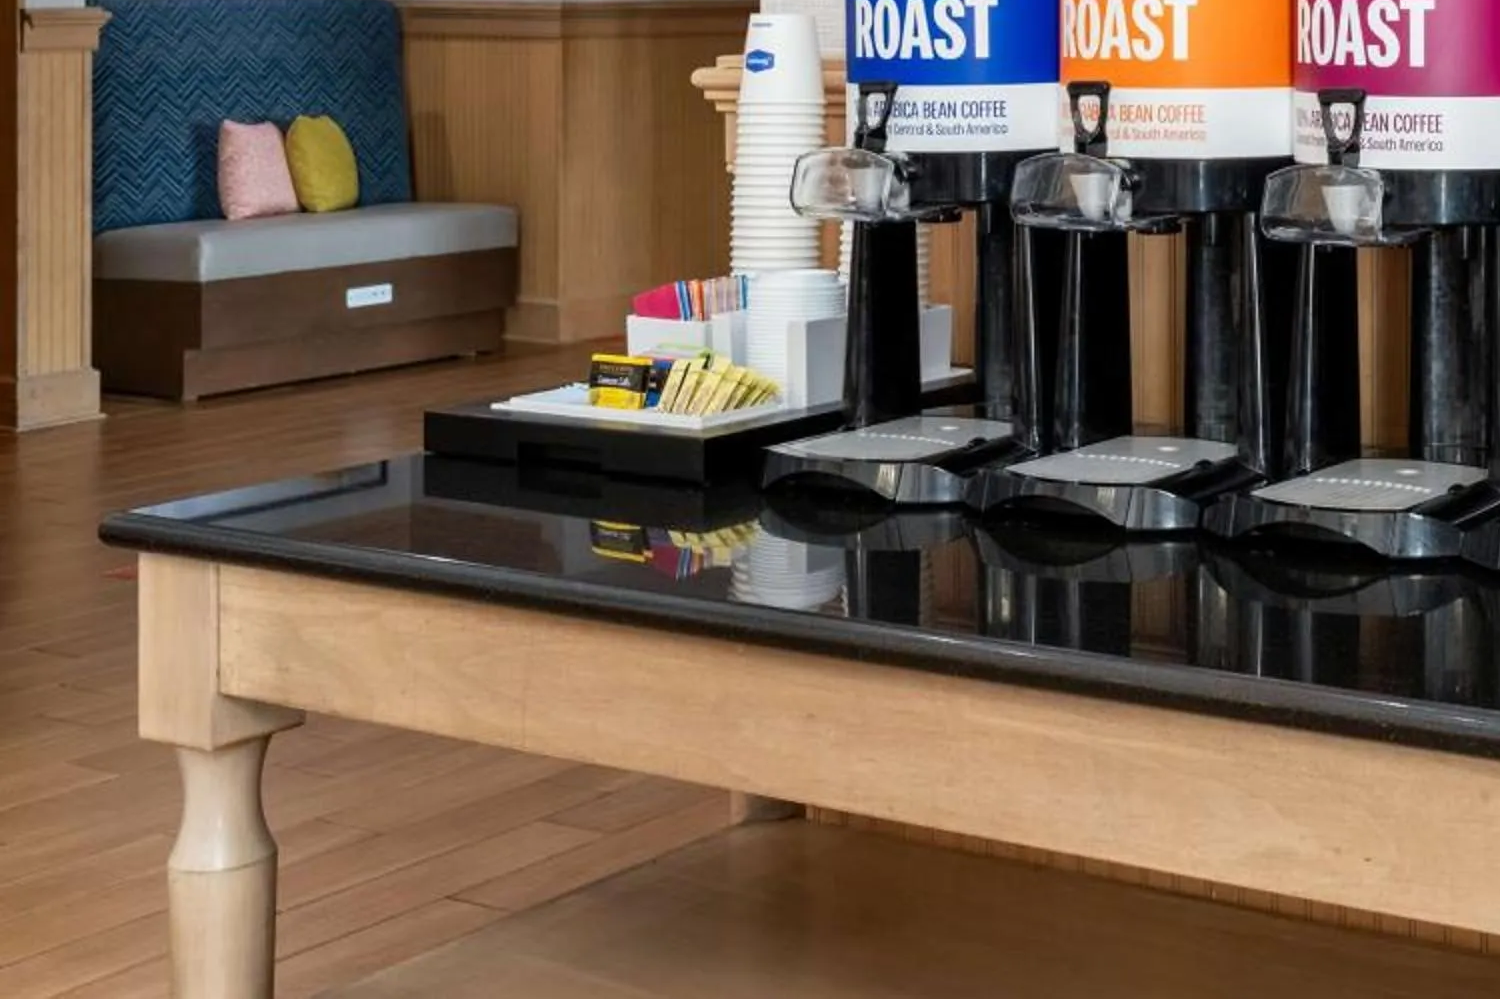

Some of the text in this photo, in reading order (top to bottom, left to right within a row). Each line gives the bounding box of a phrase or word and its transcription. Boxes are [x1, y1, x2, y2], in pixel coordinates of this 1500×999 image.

[923, 100, 957, 119] BEAN
[961, 100, 1007, 119] COFFEE
[1119, 103, 1154, 123] BEAN
[1157, 104, 1207, 124] COFFEE
[926, 123, 933, 136] &
[935, 122, 965, 136] South
[967, 122, 1009, 136] America
[1362, 112, 1390, 133] EAN
[1393, 114, 1443, 134] COFFEE
[1163, 128, 1208, 142] America
[1366, 136, 1397, 151] South
[1399, 137, 1443, 152] America
